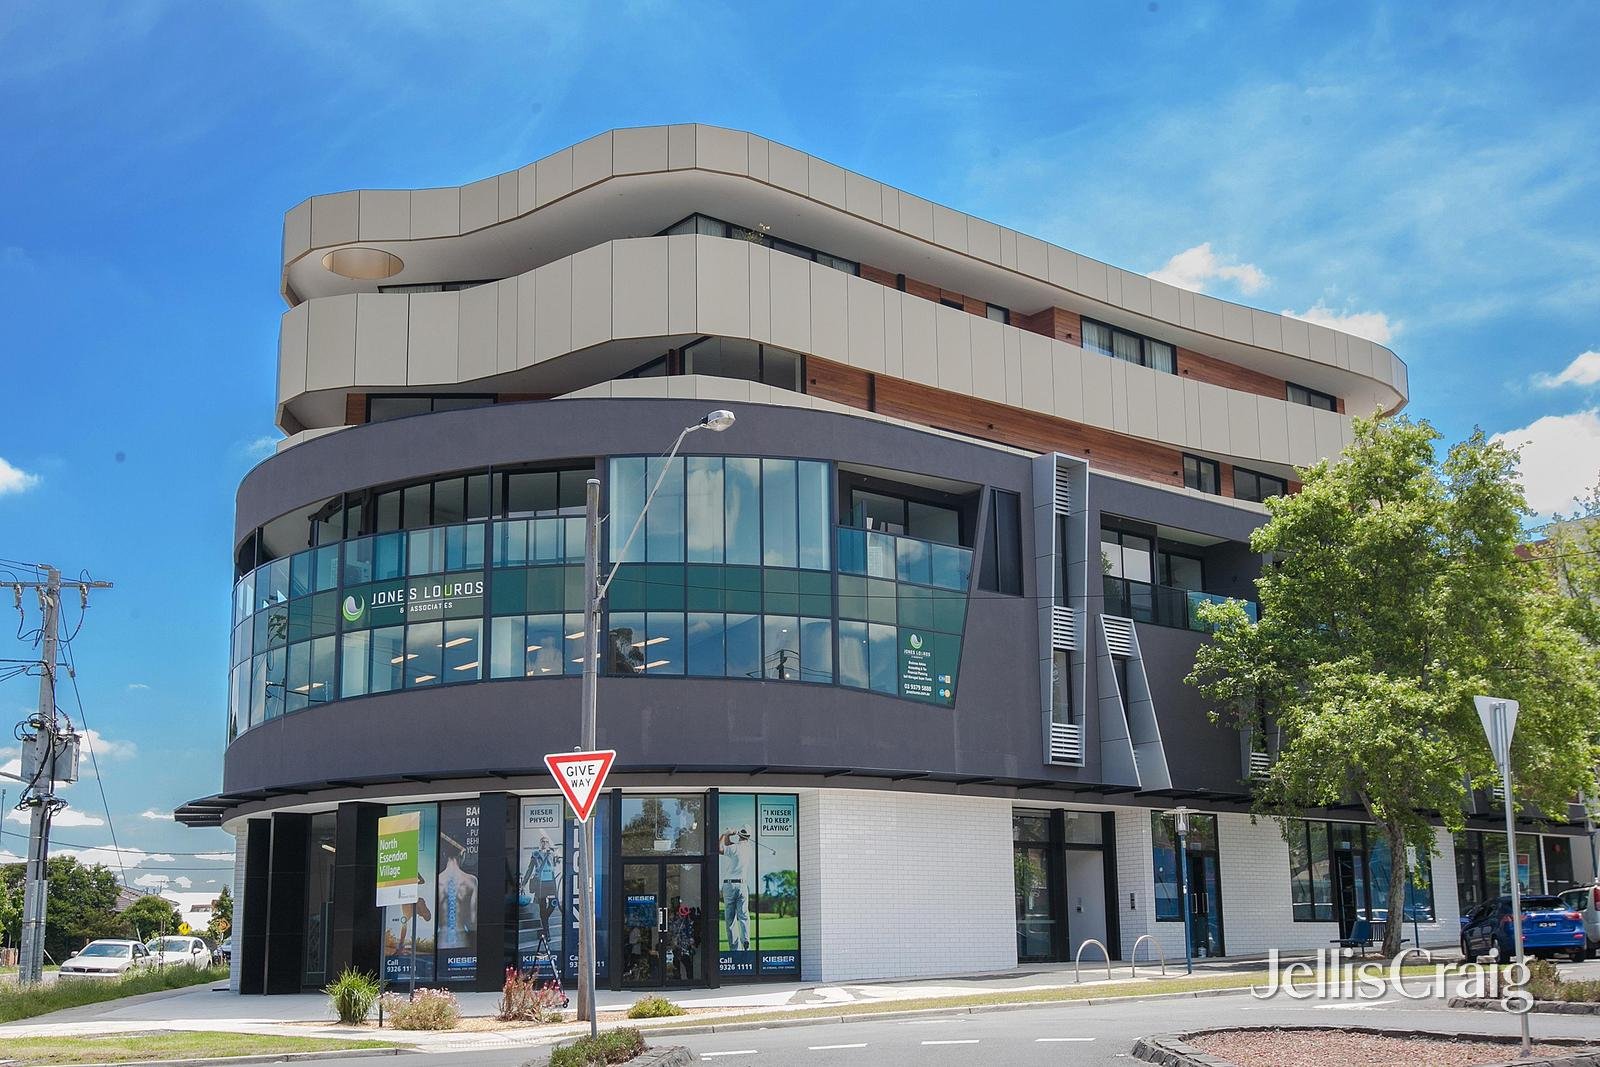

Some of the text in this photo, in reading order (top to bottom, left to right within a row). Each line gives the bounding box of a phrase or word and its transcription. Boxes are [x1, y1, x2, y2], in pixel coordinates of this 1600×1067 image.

[371, 581, 484, 605] JONES LOUROS
[410, 602, 453, 612] ASSOCIATES
[566, 764, 596, 777] GIVE
[571, 778, 592, 788] WAY
[466, 806, 480, 816] BA
[465, 817, 480, 827] PAI
[470, 829, 479, 837] PU
[380, 837, 398, 850] North
[466, 837, 480, 845] BEHI
[380, 850, 408, 863] Essendon
[380, 866, 401, 878] Village
[447, 956, 478, 964] KIESER
[522, 954, 558, 962] KIER
[719, 956, 732, 964] Call
[762, 955, 795, 963] KIESER
[386, 965, 417, 973] 9326 111
